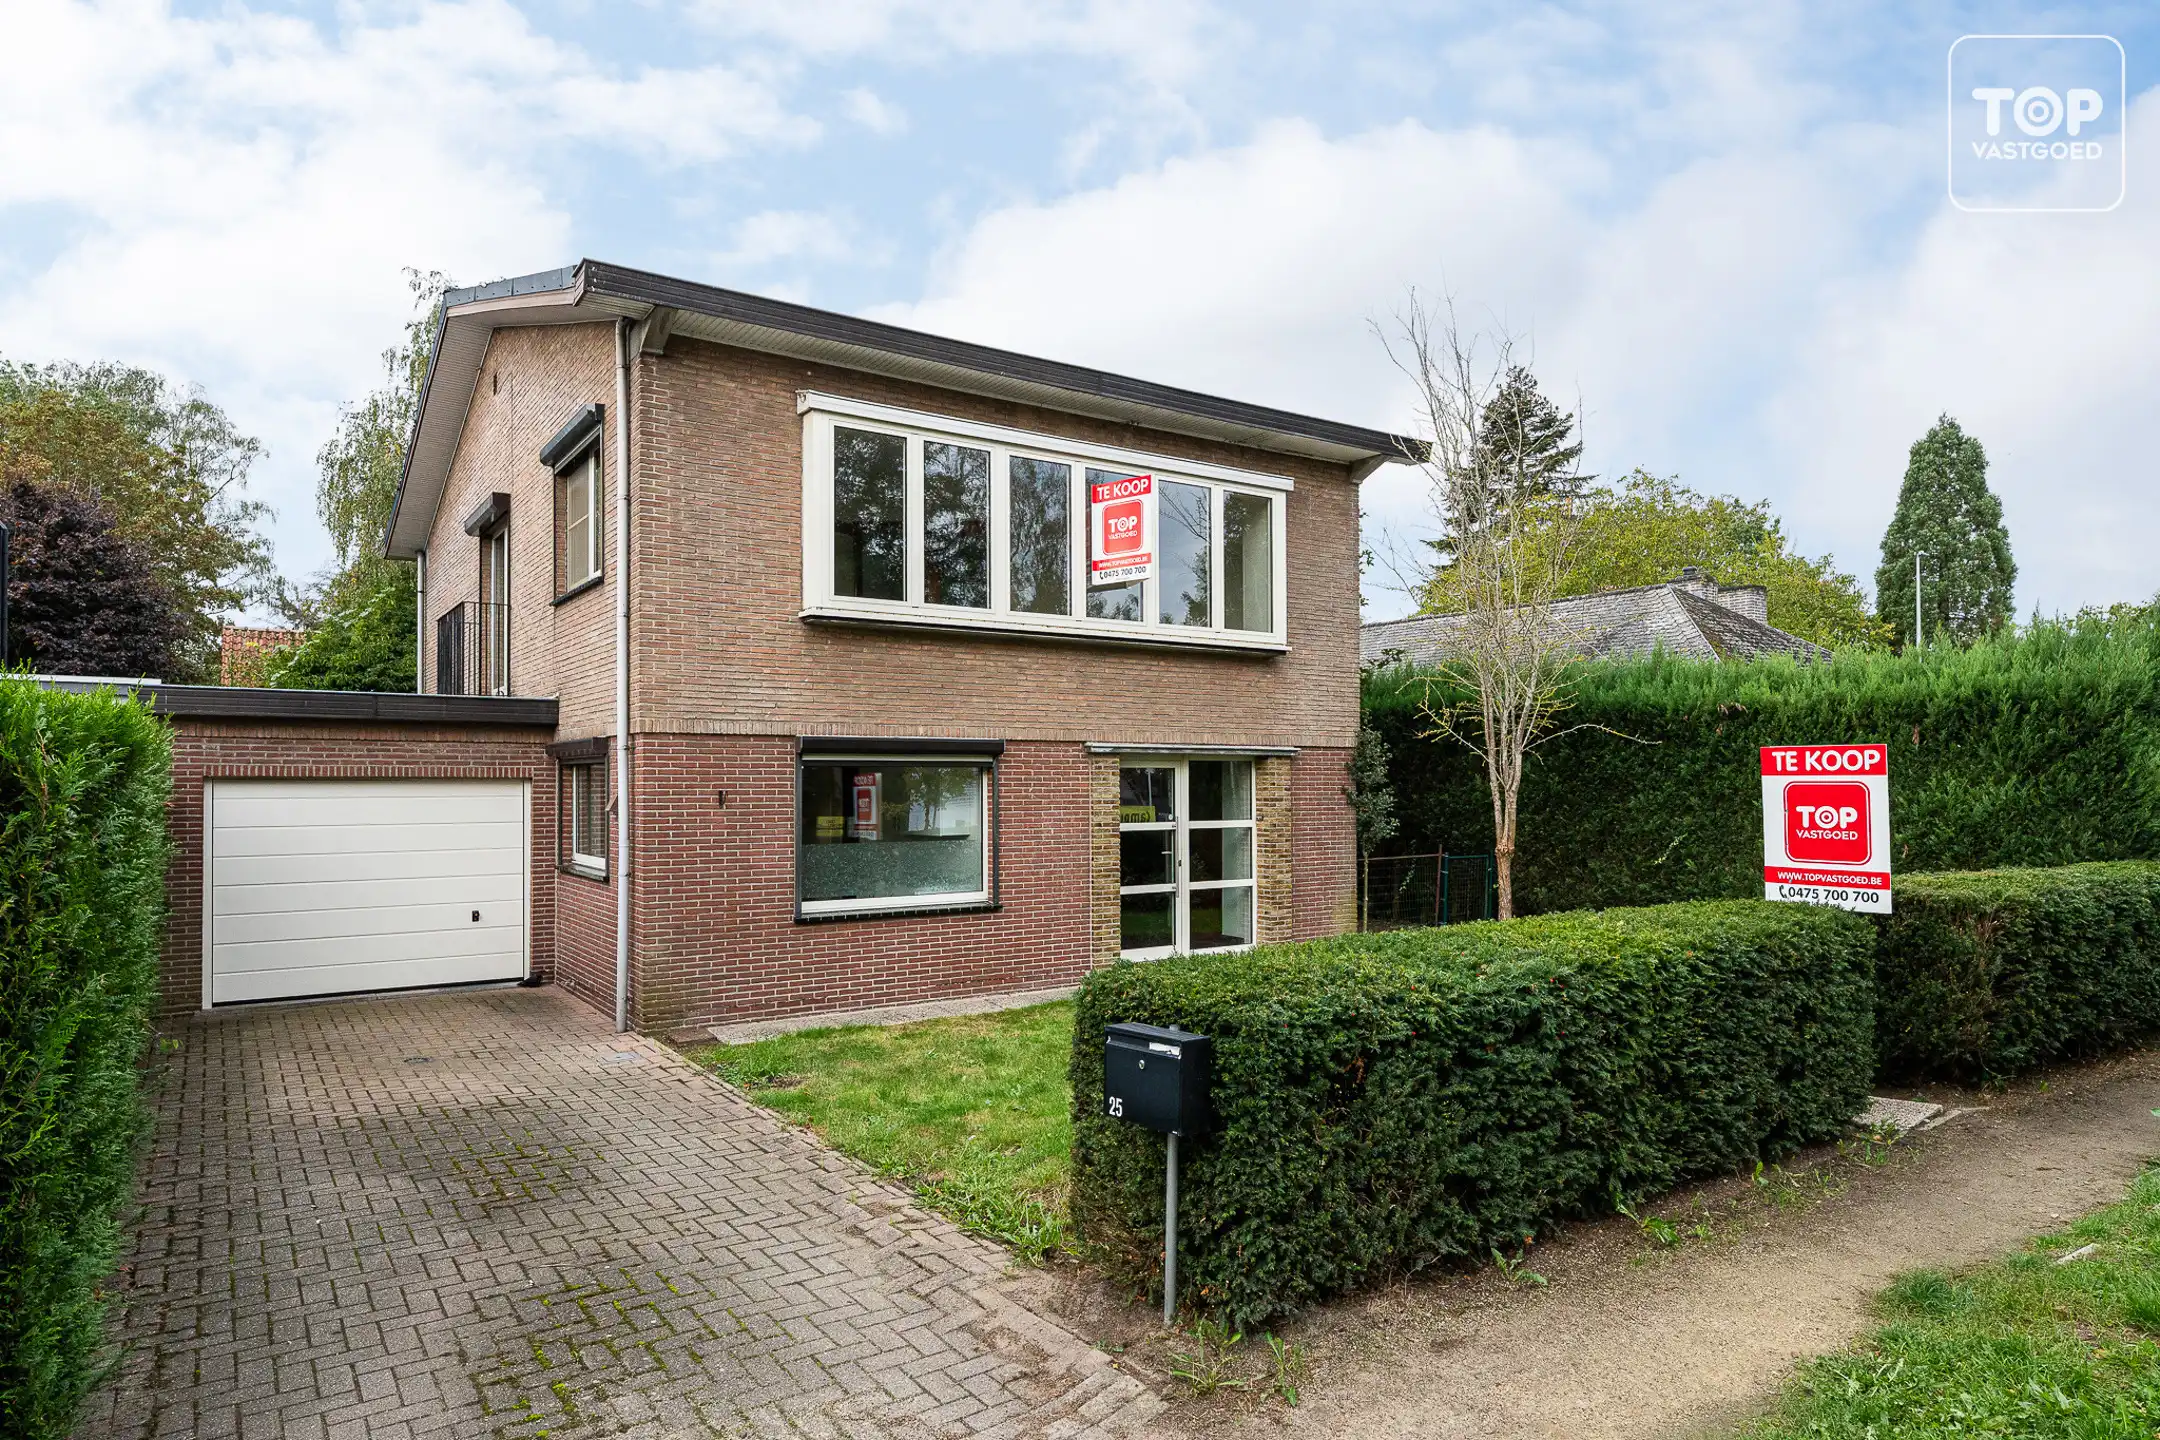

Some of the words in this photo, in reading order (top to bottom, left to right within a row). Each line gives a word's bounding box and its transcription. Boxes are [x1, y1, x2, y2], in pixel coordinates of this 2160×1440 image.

[1097, 486, 1110, 500] TE
[1113, 478, 1149, 498] KOOP
[1108, 515, 1138, 533] TOP
[1103, 569, 1119, 579] 0475
[1121, 567, 1133, 576] 700
[1134, 565, 1147, 574] 700
[1772, 751, 1798, 772] TE
[1805, 749, 1881, 771] KOOP
[1796, 806, 1858, 829] TOP
[1796, 830, 1858, 840] VASTGOED
[1777, 871, 1882, 885] WWW.TOPVASTGOED.BE
[1788, 886, 1819, 899] 0475
[1823, 889, 1849, 901] 700
[1853, 891, 1879, 903] 700
[1109, 1096, 1123, 1117] 25
